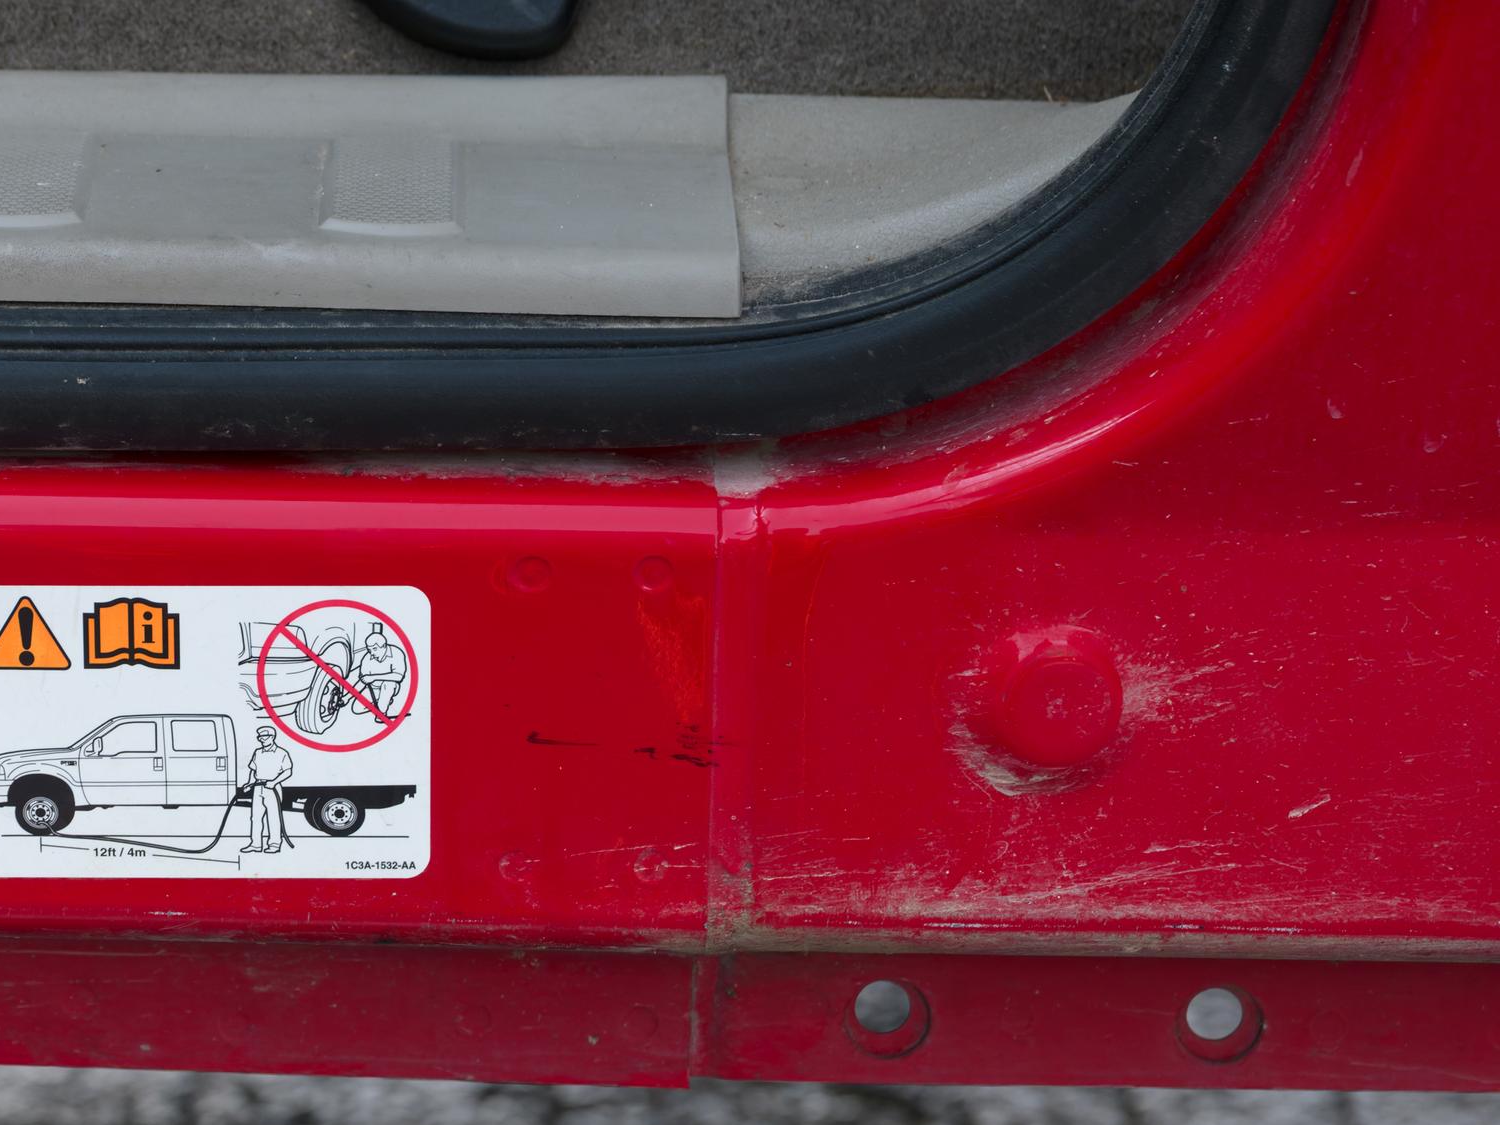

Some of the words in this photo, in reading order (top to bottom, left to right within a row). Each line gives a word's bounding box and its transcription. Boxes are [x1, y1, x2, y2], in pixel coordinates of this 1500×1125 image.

[93, 847, 116, 857] 12ft
[119, 847, 124, 857] /
[127, 847, 146, 857] 4m
[345, 861, 416, 870] 1C3A-1532-AA
